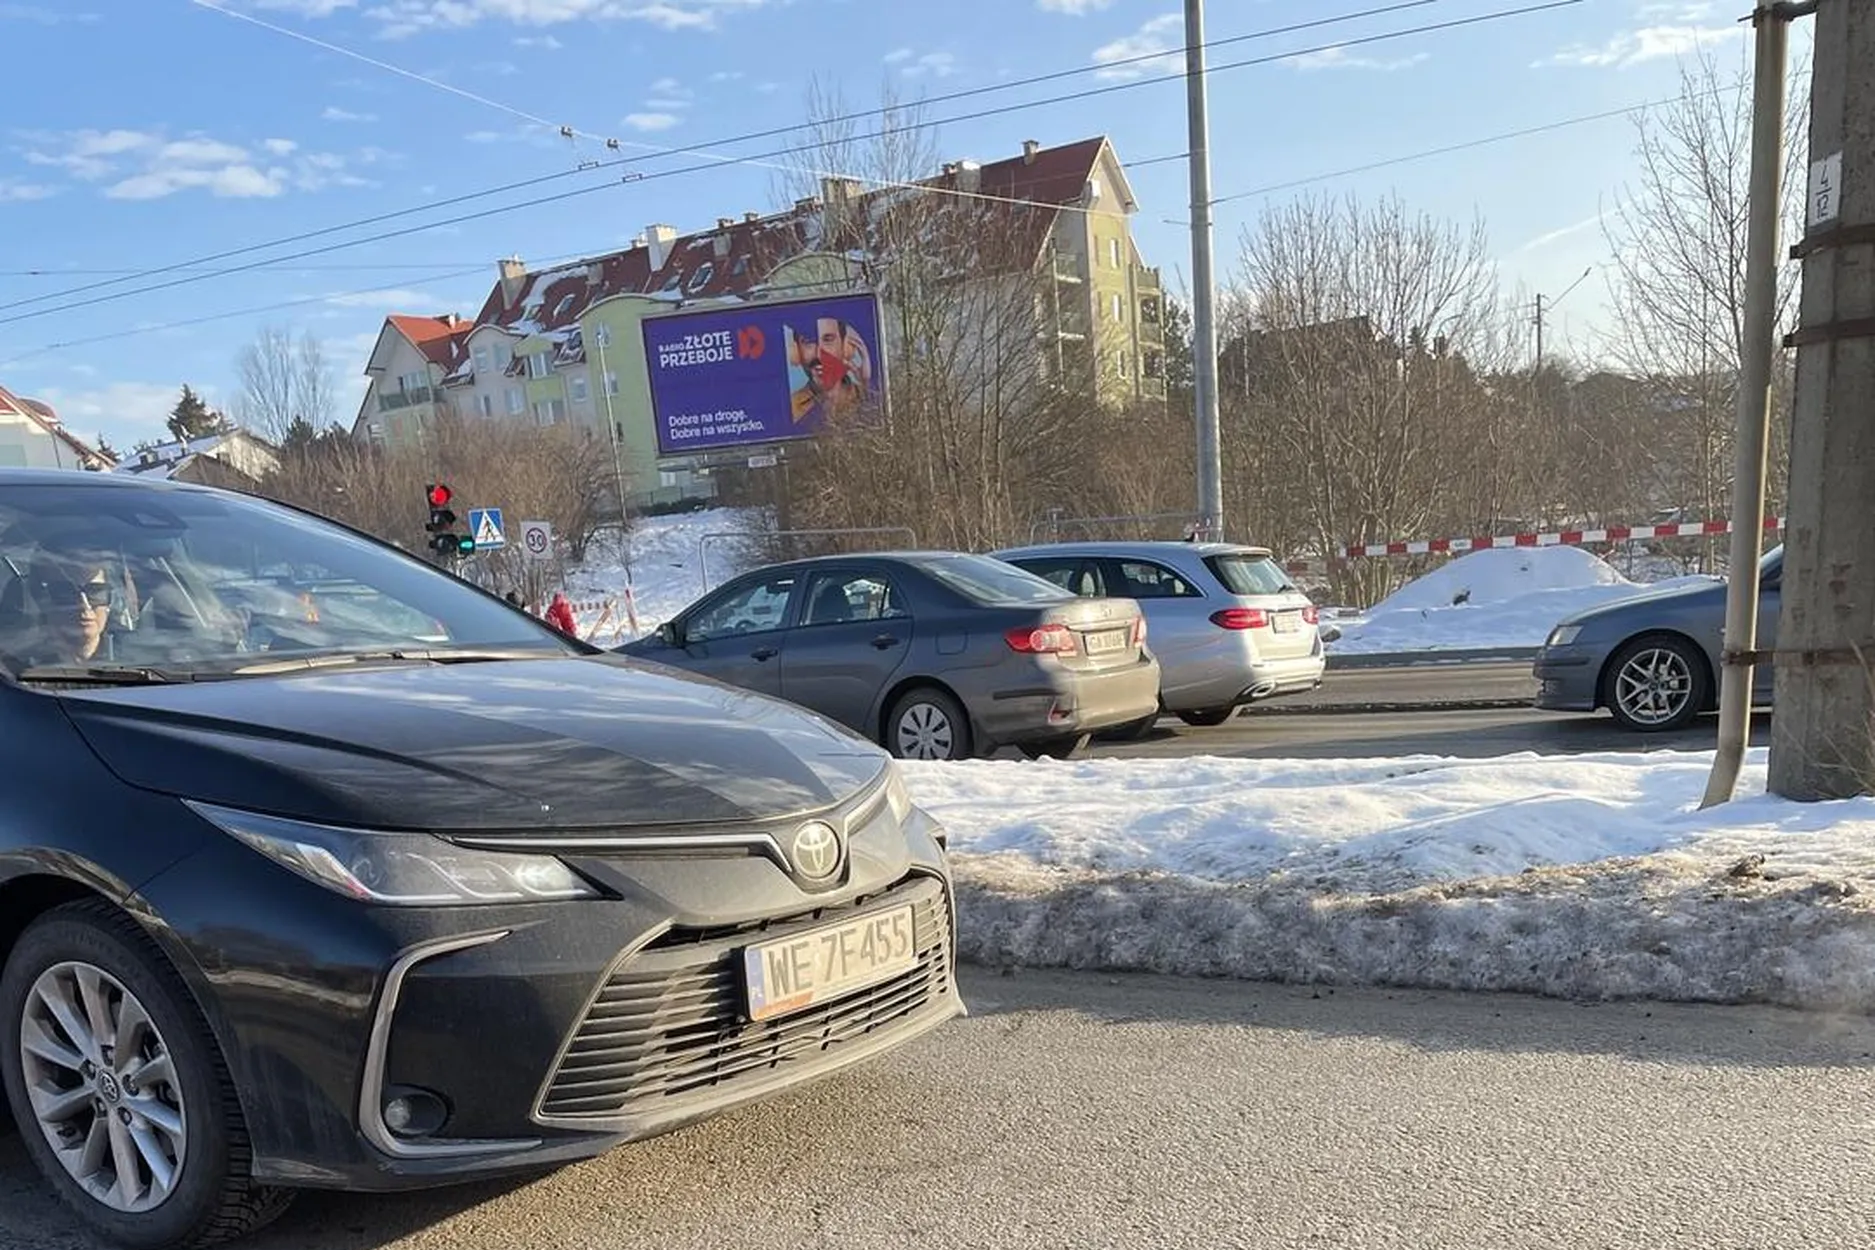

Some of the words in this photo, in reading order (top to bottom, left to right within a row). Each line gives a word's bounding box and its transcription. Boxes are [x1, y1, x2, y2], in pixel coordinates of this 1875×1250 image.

[684, 331, 731, 349] ZŁOTE
[660, 347, 733, 368] PRZEBOJE
[669, 414, 698, 427] Dobre
[701, 413, 713, 423] na
[671, 428, 700, 440] Dobre
[703, 426, 715, 436] na
[768, 941, 814, 998] WE
